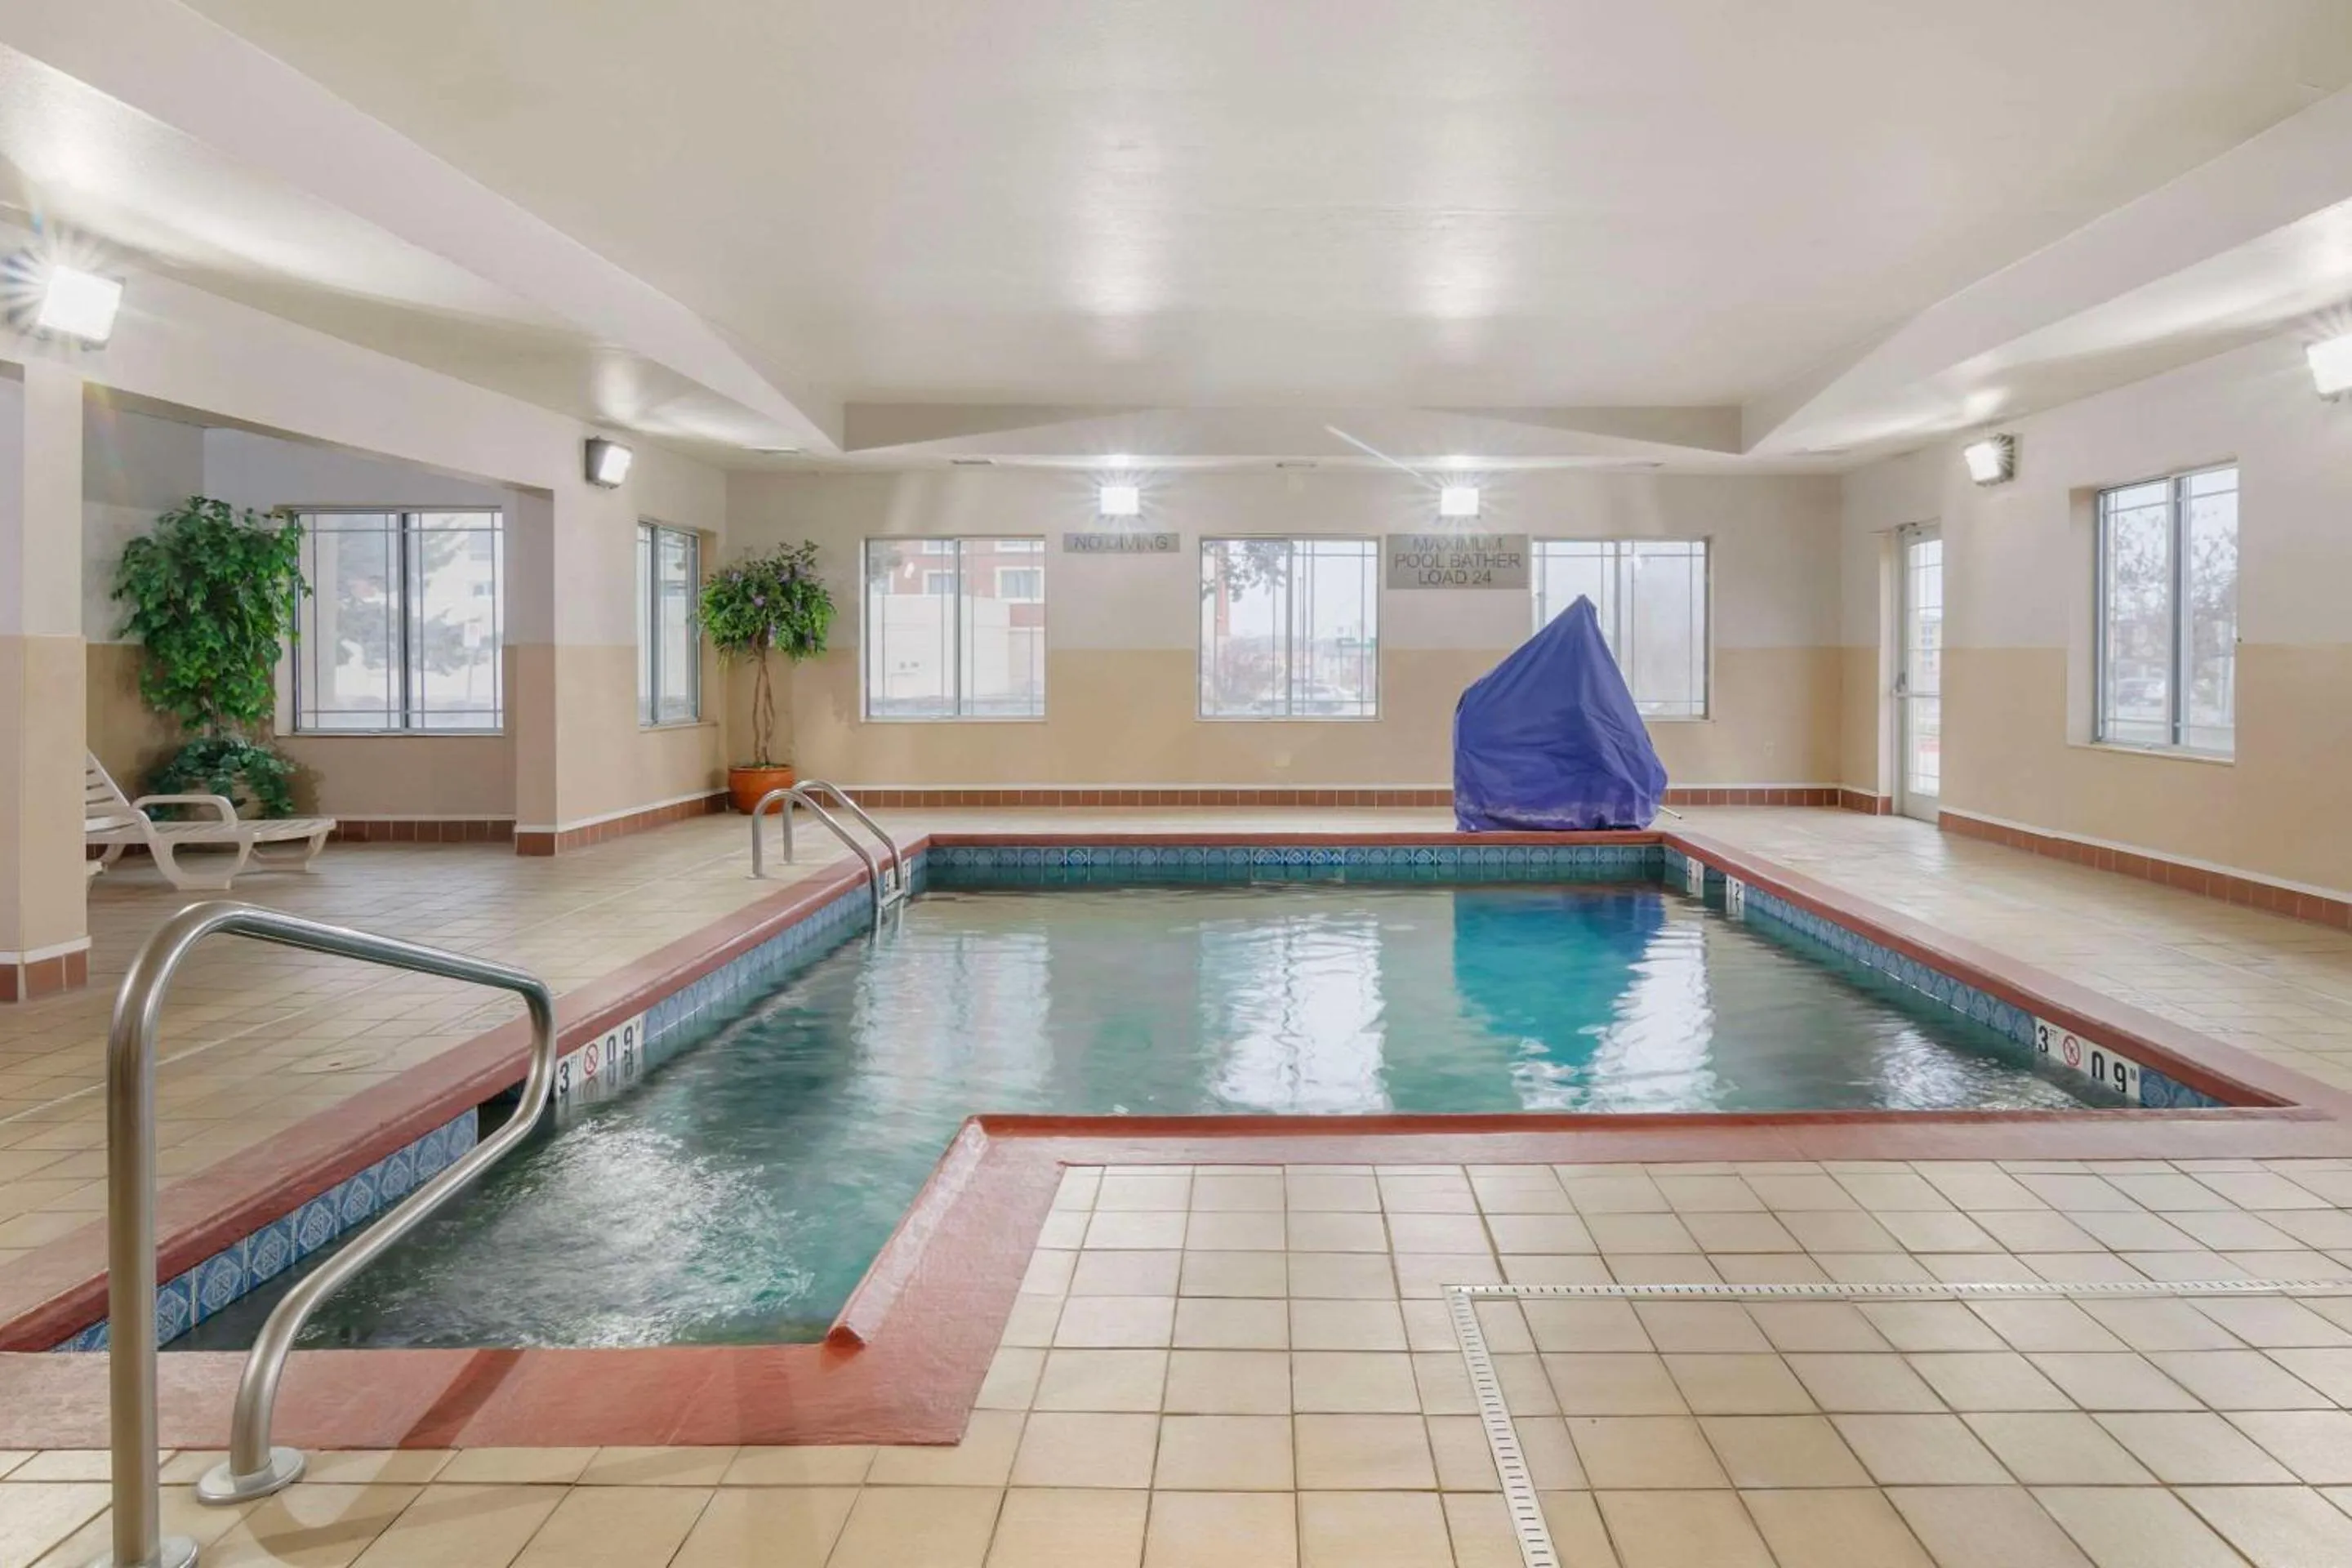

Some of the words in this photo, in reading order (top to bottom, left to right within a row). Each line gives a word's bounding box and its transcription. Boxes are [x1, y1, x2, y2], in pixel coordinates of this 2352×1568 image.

[1394, 553, 1445, 568] POOL
[1450, 552, 1522, 568] BATHER
[1418, 570, 1468, 585] LOAD
[1472, 569, 1492, 585] 24
[2038, 1025, 2048, 1053] 3
[559, 1061, 570, 1094] 3
